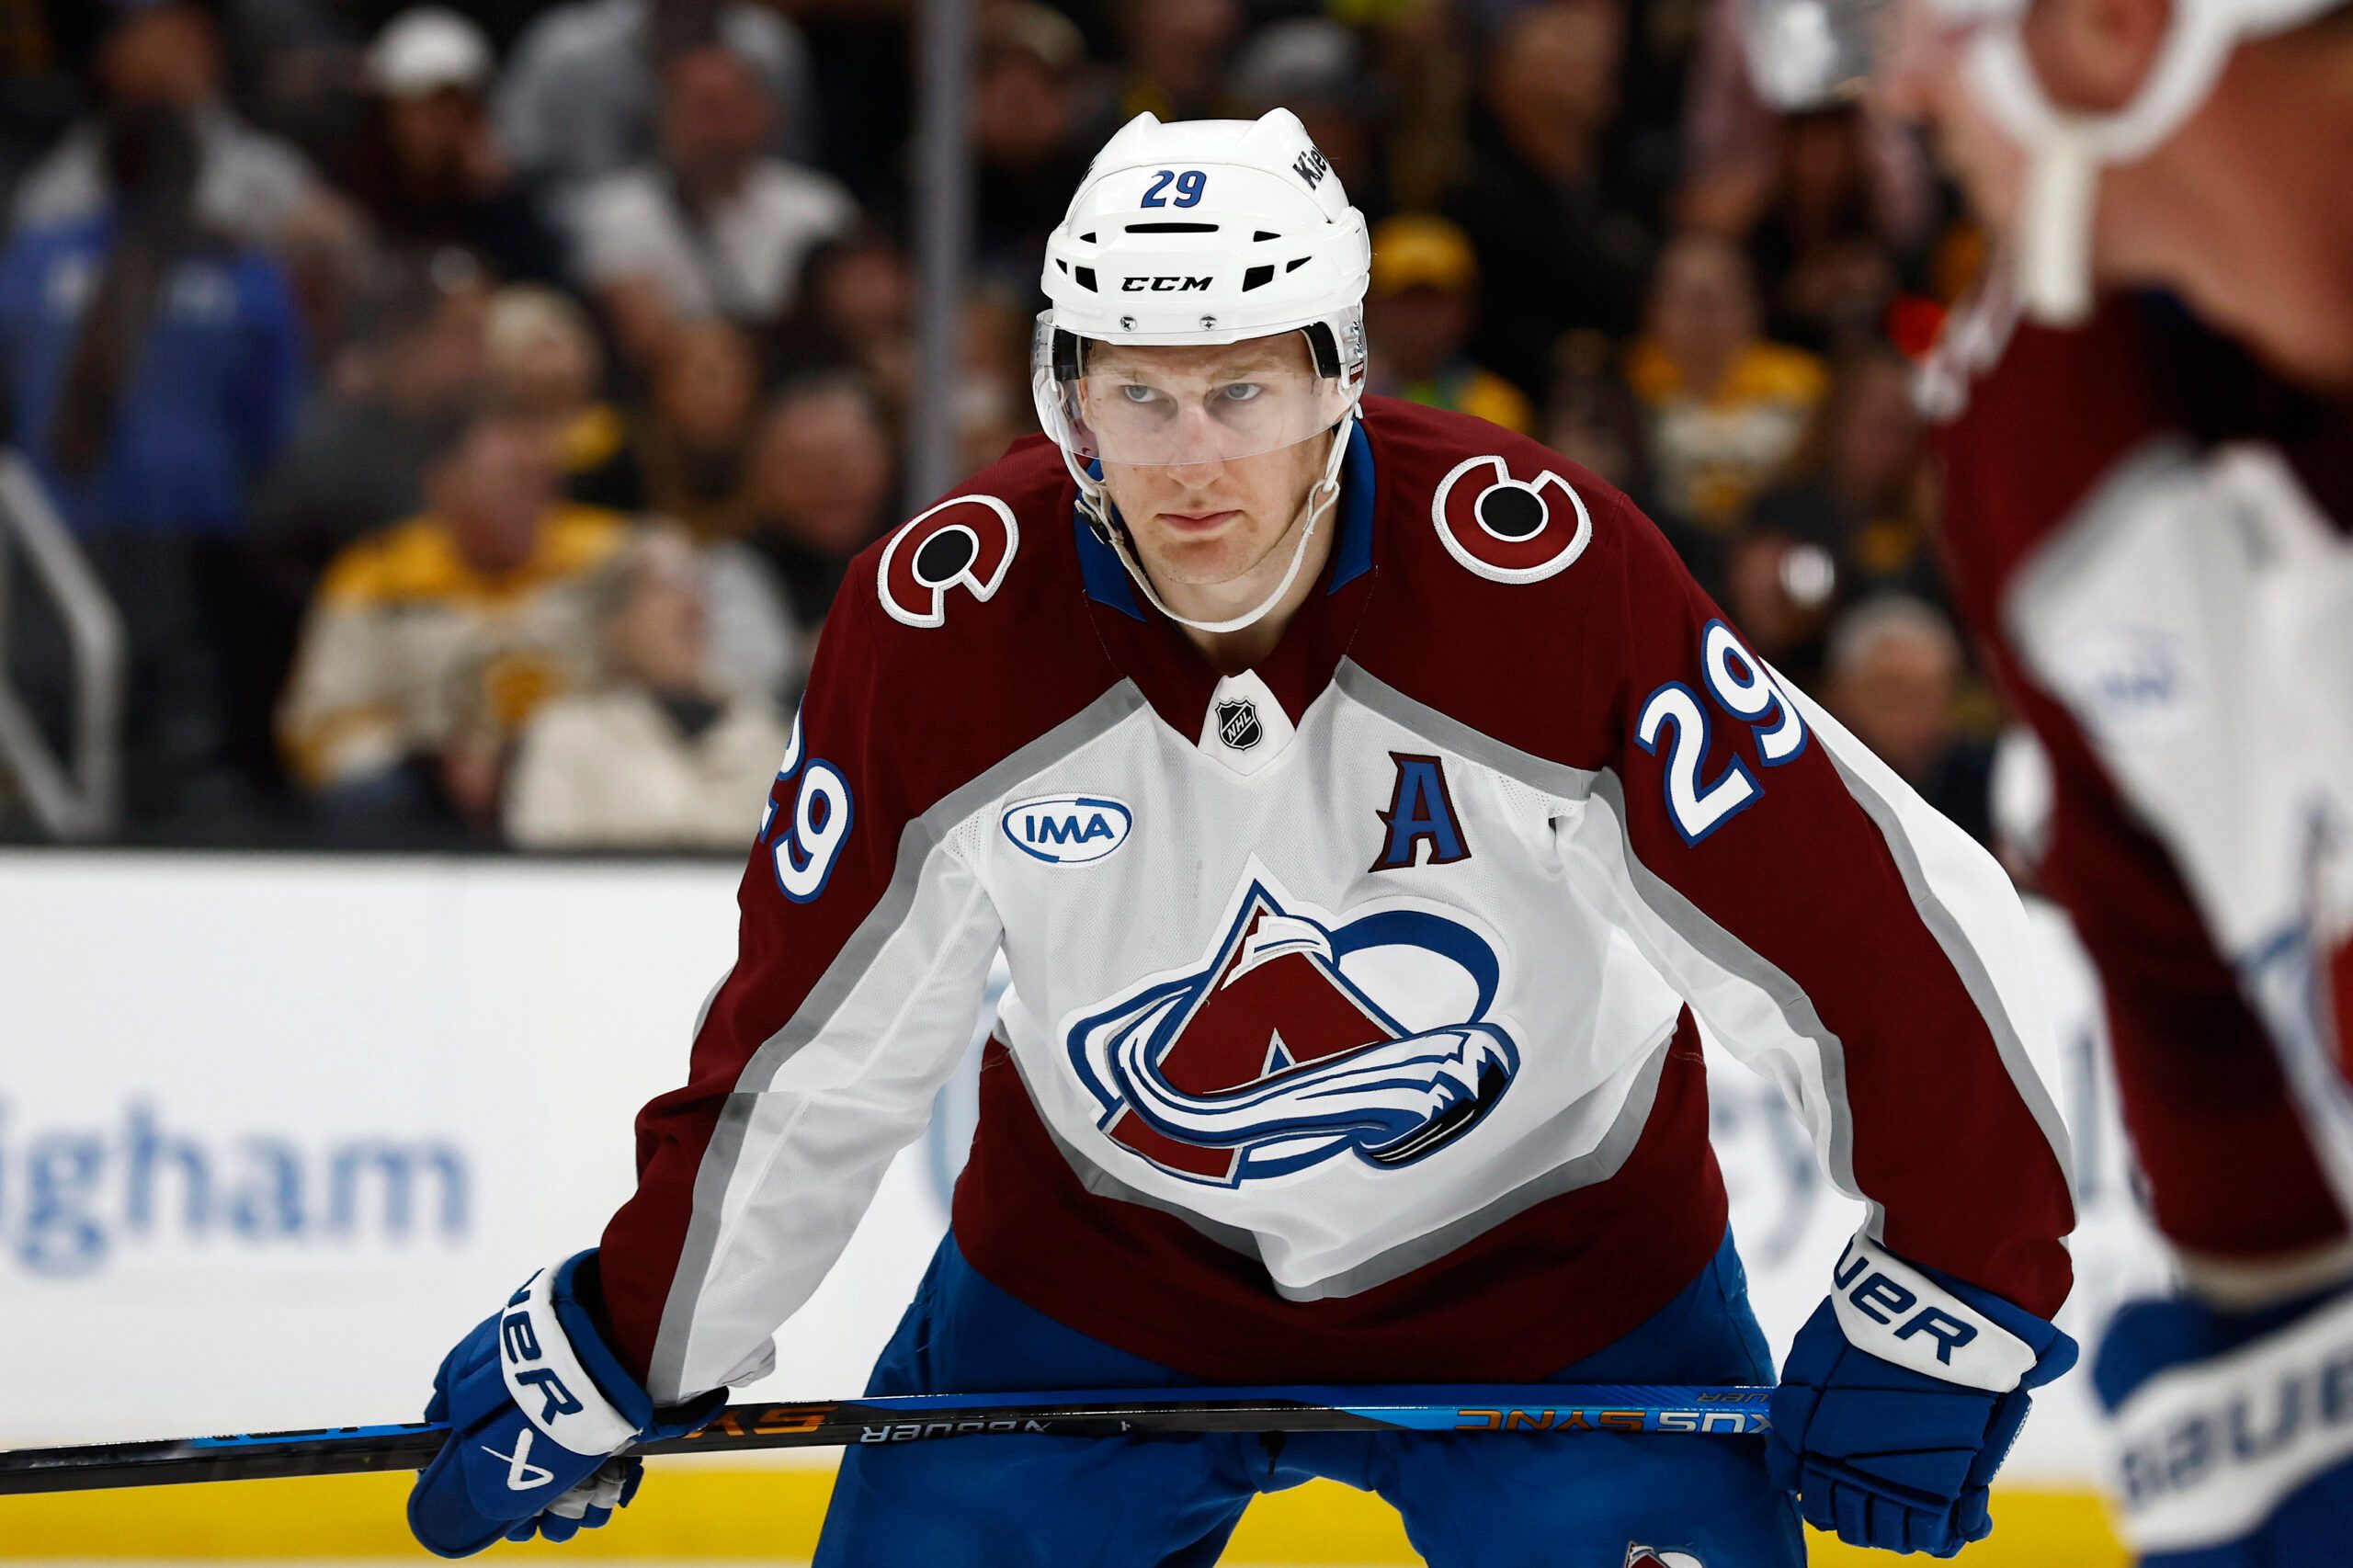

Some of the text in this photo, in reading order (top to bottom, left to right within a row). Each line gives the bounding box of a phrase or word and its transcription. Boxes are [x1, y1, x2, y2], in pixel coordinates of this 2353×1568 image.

[1292, 145, 1328, 191] Kie
[1141, 170, 1207, 208] 29
[1121, 277, 1213, 291] CCM
[1227, 710, 1252, 742] NHL
[1633, 617, 1808, 848] 29
[1026, 813, 1114, 844] IMA
[1368, 751, 1472, 873] A
[1456, 1409, 1647, 1431] SYNC
